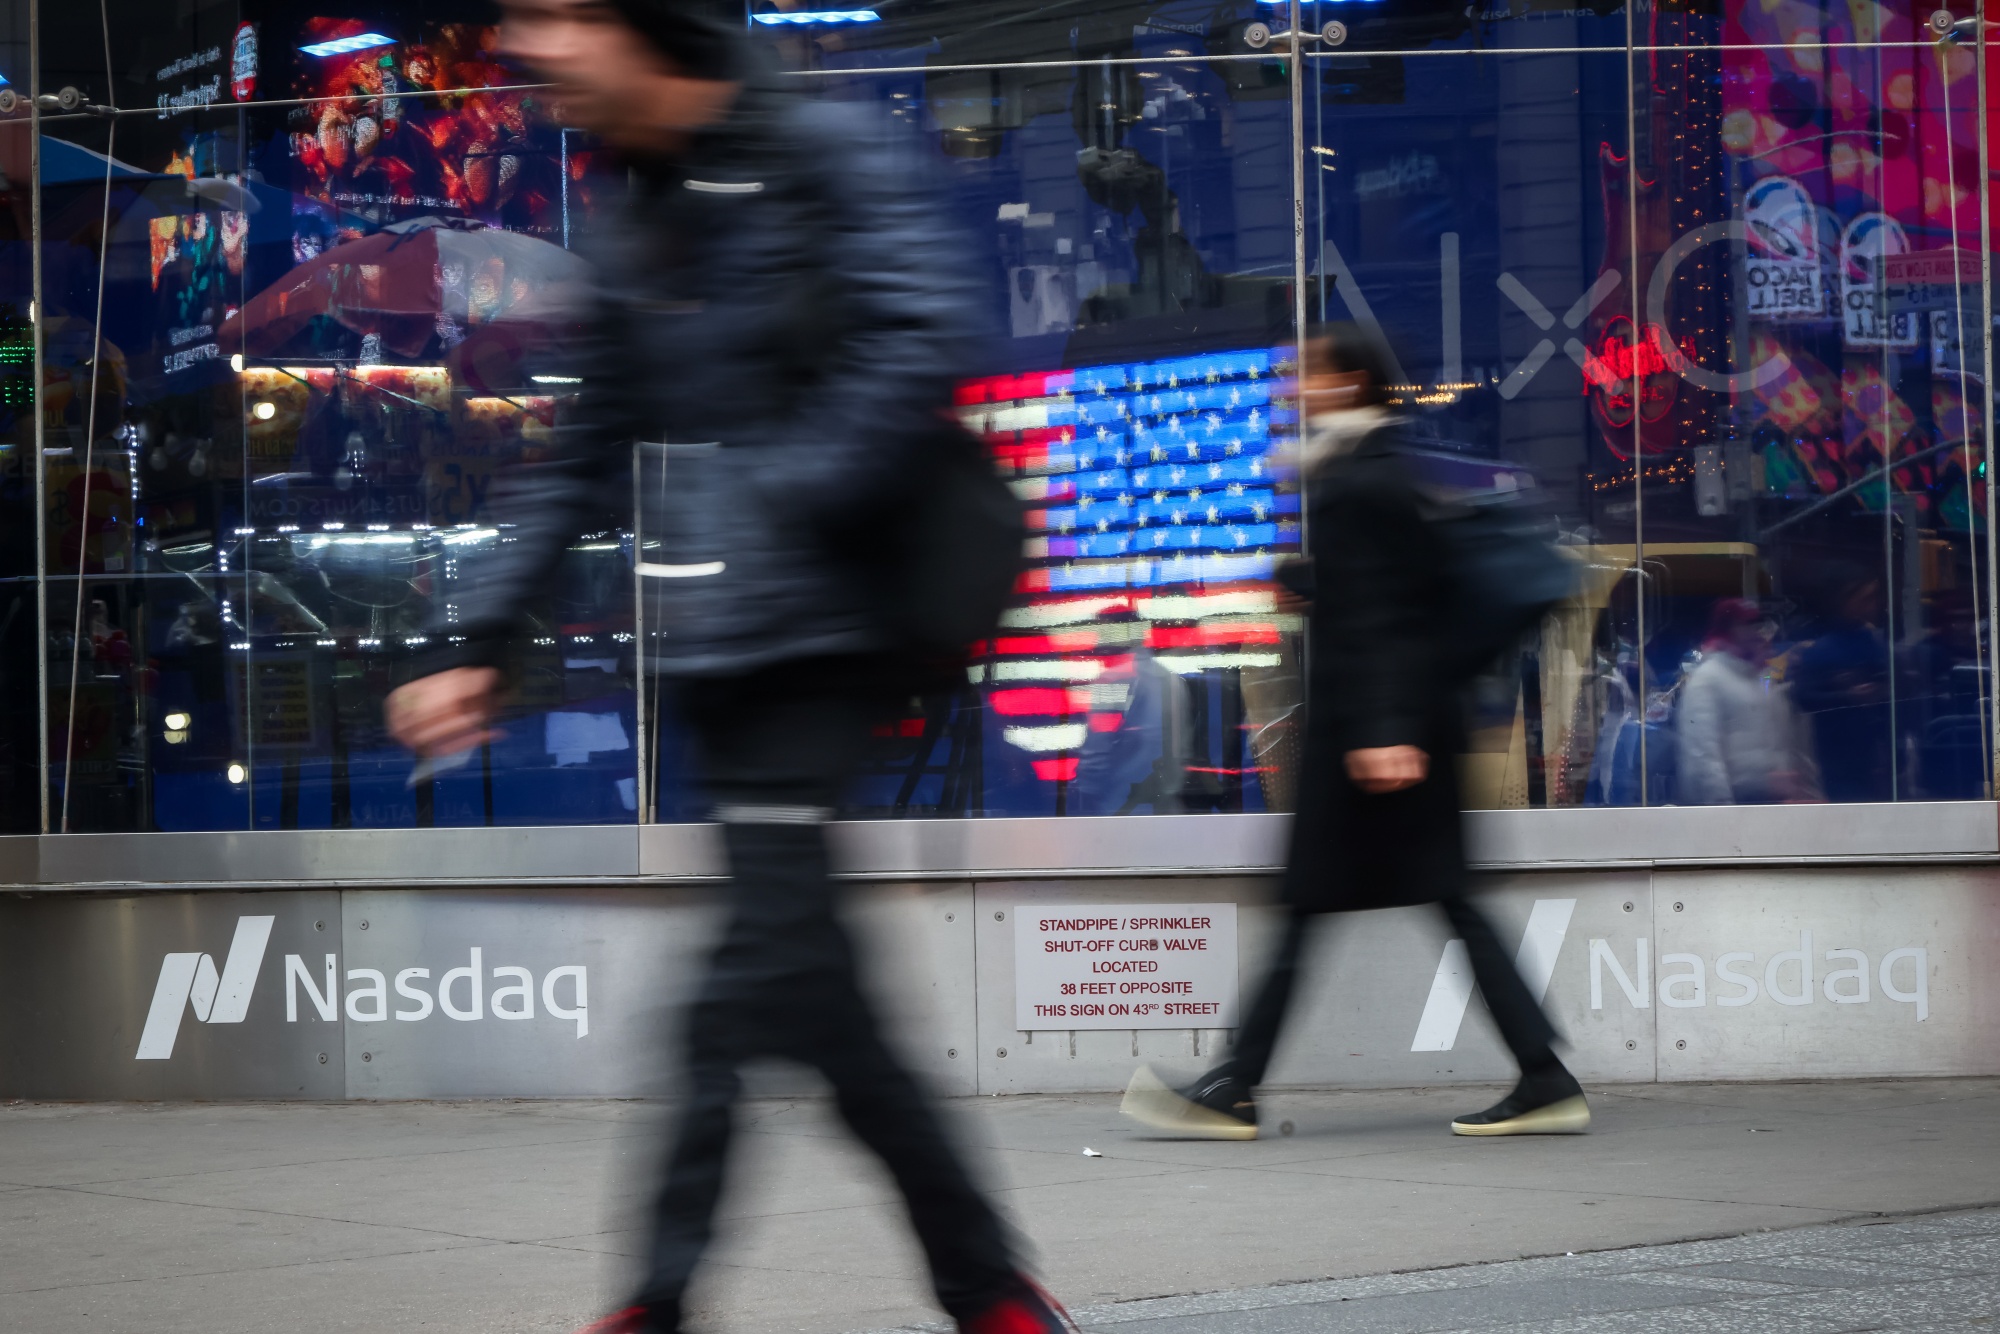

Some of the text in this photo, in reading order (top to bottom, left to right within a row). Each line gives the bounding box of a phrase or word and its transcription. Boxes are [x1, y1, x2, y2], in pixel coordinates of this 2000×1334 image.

[1039, 918, 1118, 932] STANDPIPE
[1129, 917, 1211, 931] SPRINKLER
[1044, 938, 1207, 953] SHUT-OFF CURB VALVE
[1092, 961, 1158, 974] LOCATED
[1588, 929, 1929, 1023] Nasdaq
[285, 946, 589, 1040] Nasdaq
[1060, 981, 1193, 995] 38 FEET OPPOSITE
[1034, 1004, 1067, 1017] THIS
[1070, 1004, 1105, 1016] SIGN
[1108, 1003, 1130, 1016] ON
[1164, 1002, 1220, 1015] STREET
